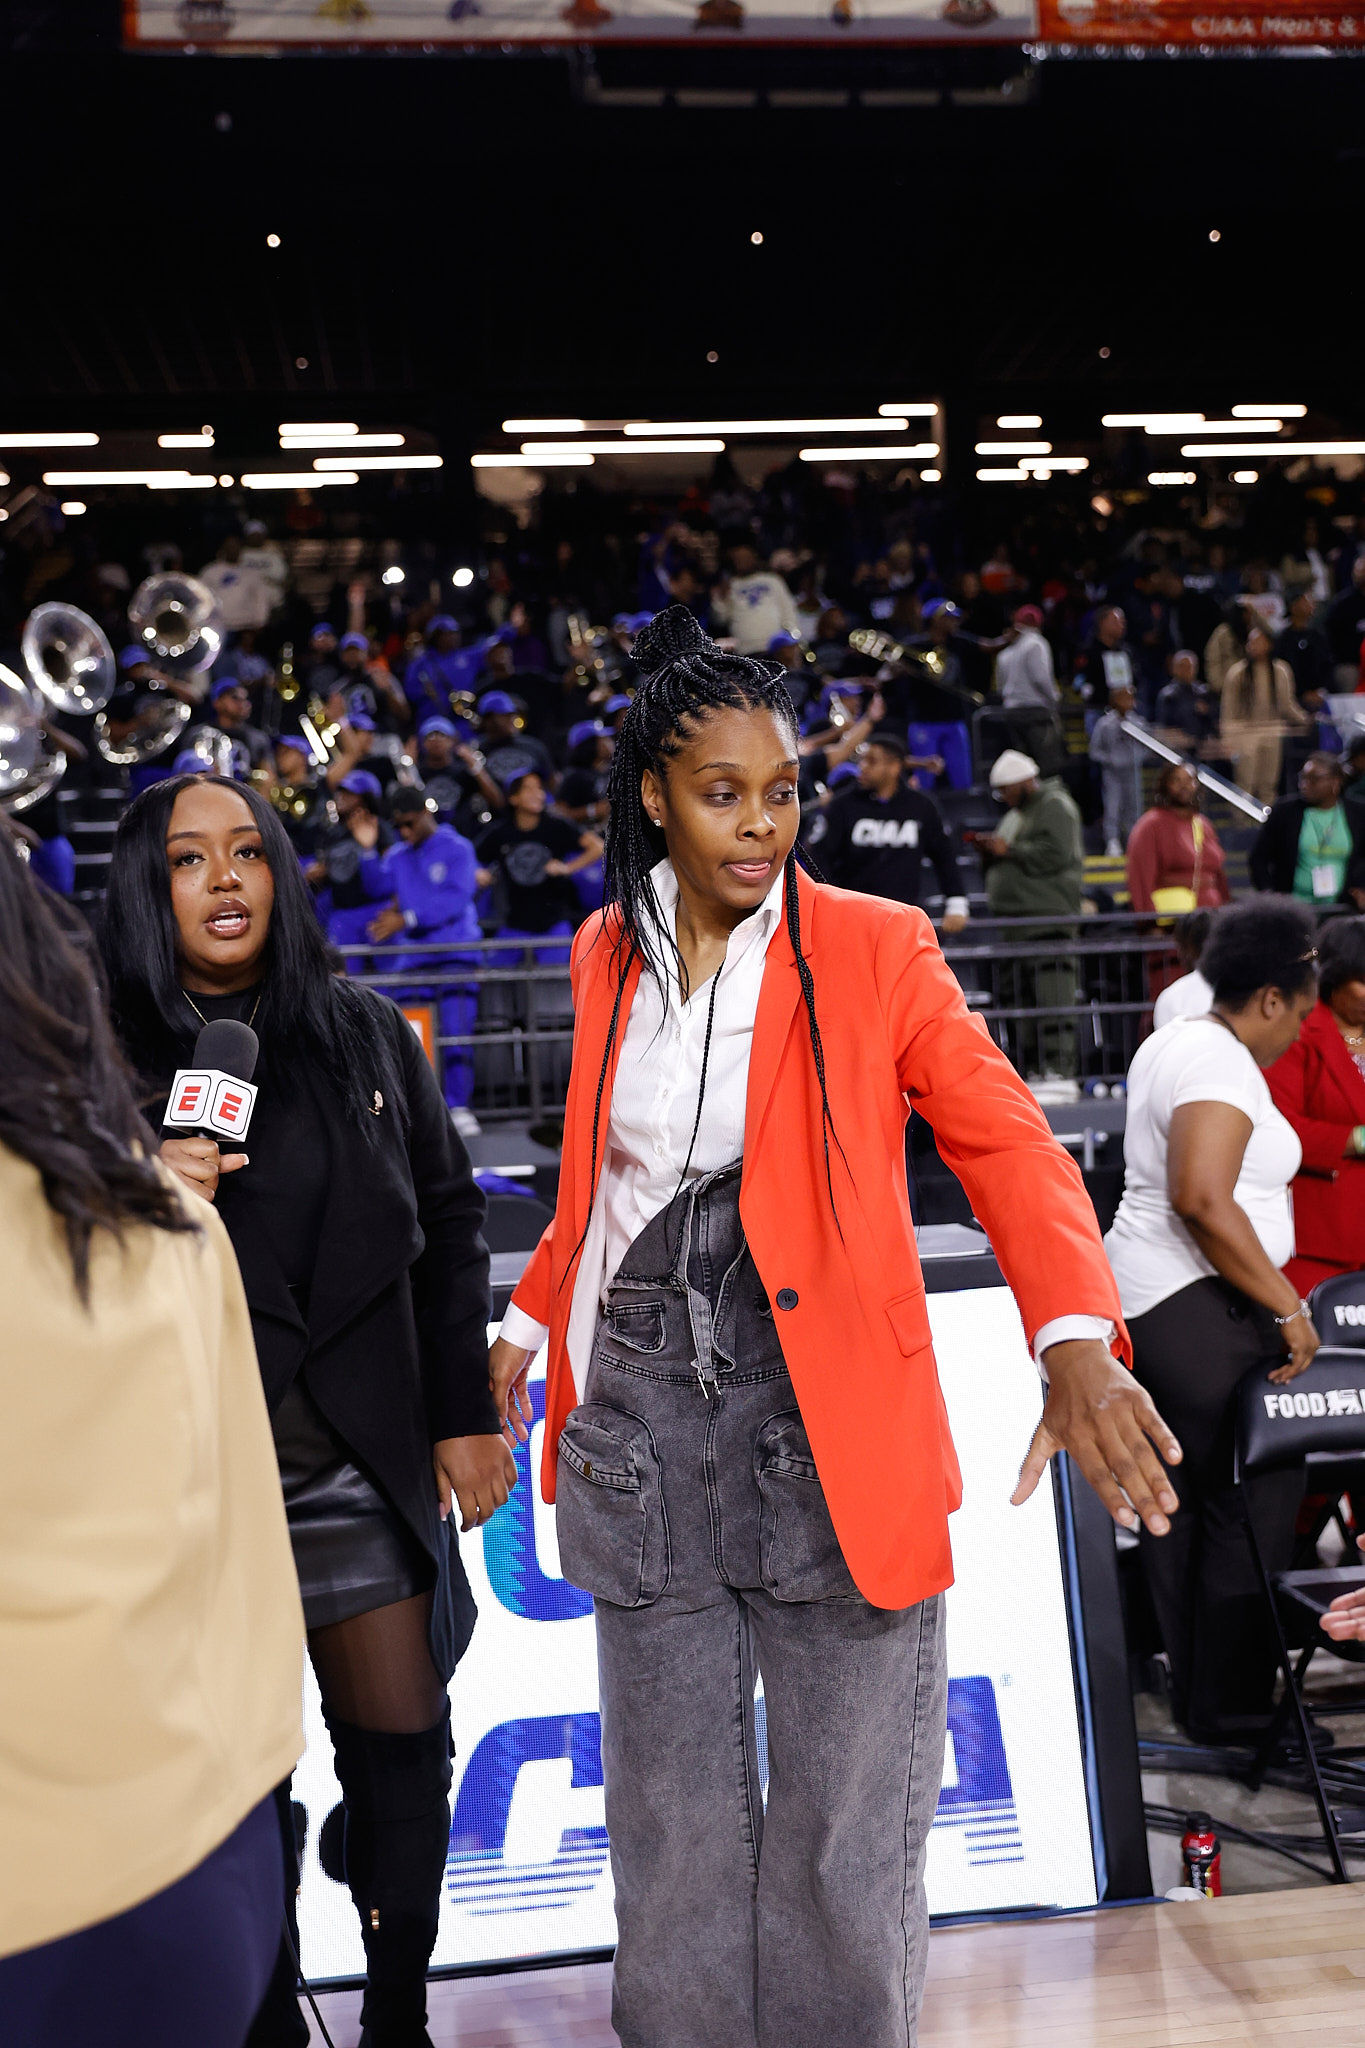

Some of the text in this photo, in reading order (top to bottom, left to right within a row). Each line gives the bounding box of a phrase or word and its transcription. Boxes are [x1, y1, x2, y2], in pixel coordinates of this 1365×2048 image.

[1191, 16, 1257, 38] CIAA
[1338, 15, 1358, 38] &
[851, 818, 920, 849] CIAA
[1263, 1392, 1327, 1419] FOOD
